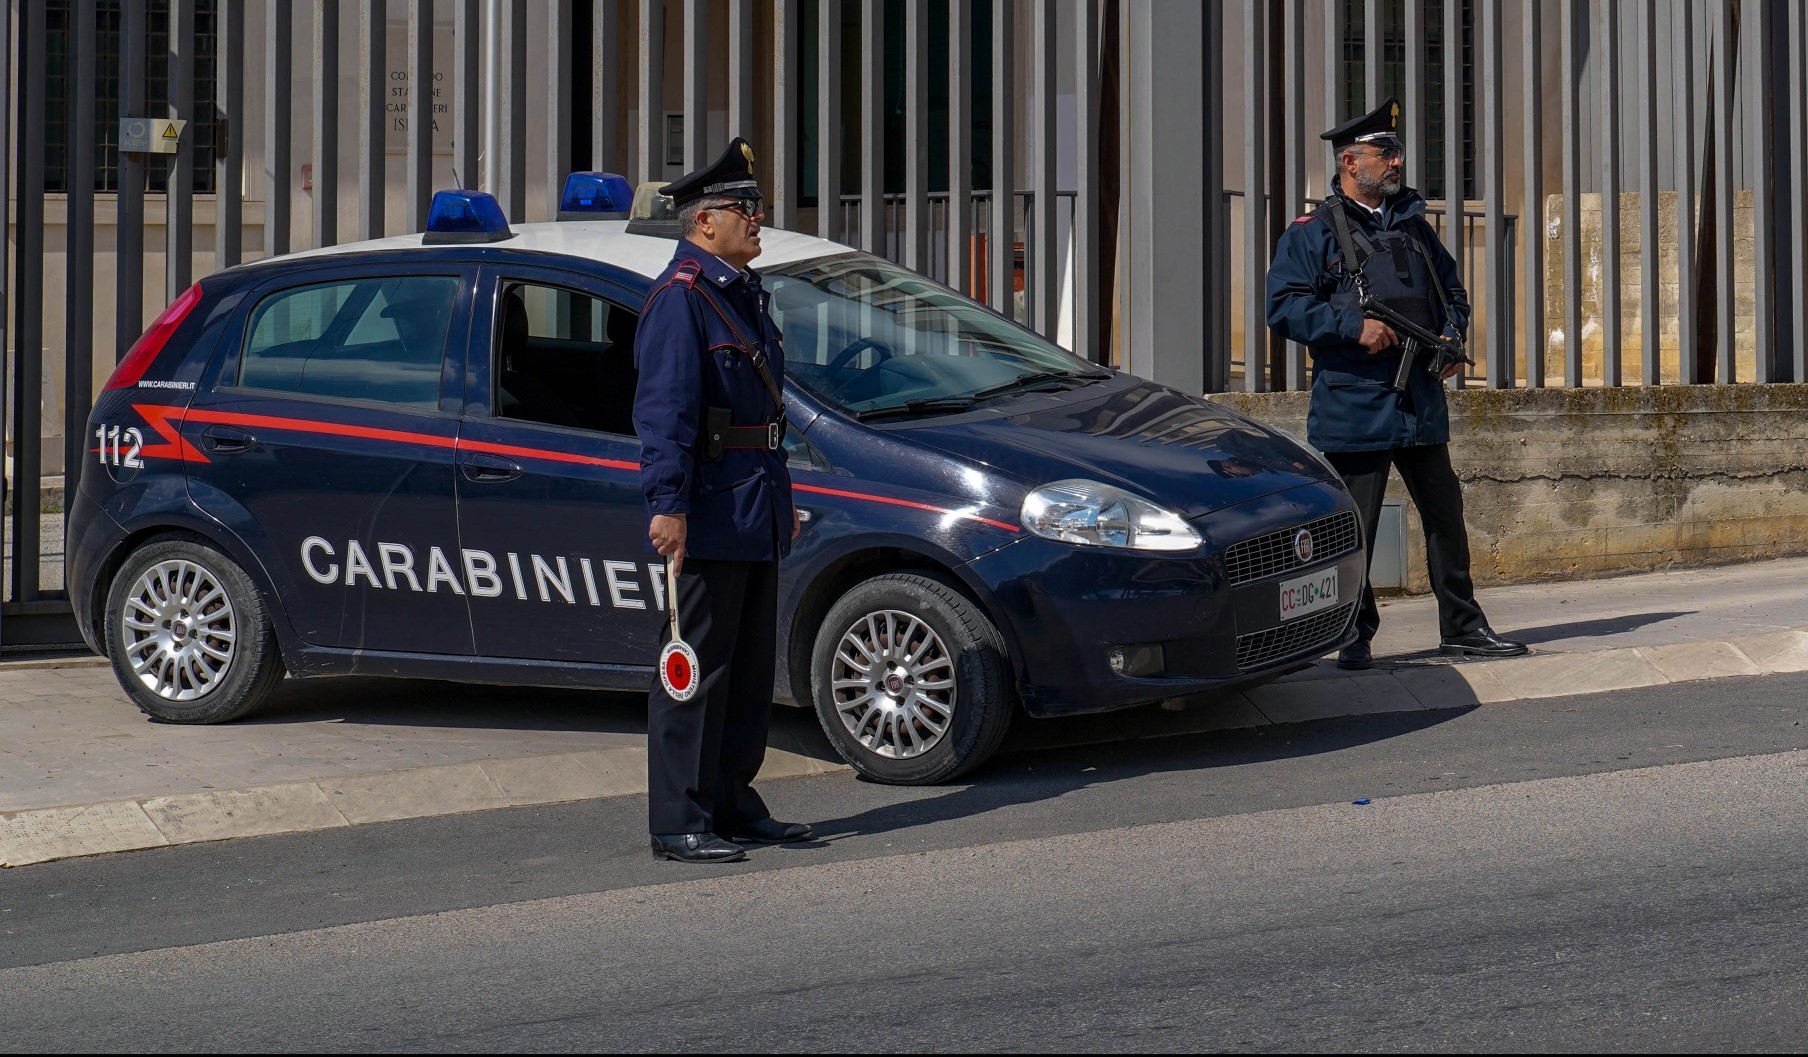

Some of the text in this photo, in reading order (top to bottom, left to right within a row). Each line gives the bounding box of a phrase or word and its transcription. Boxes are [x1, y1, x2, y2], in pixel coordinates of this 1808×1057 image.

[95, 423, 145, 469] 112
[301, 535, 665, 611] CARABINIE
[1281, 588, 1296, 612] CC
[1319, 575, 1337, 600] 421
